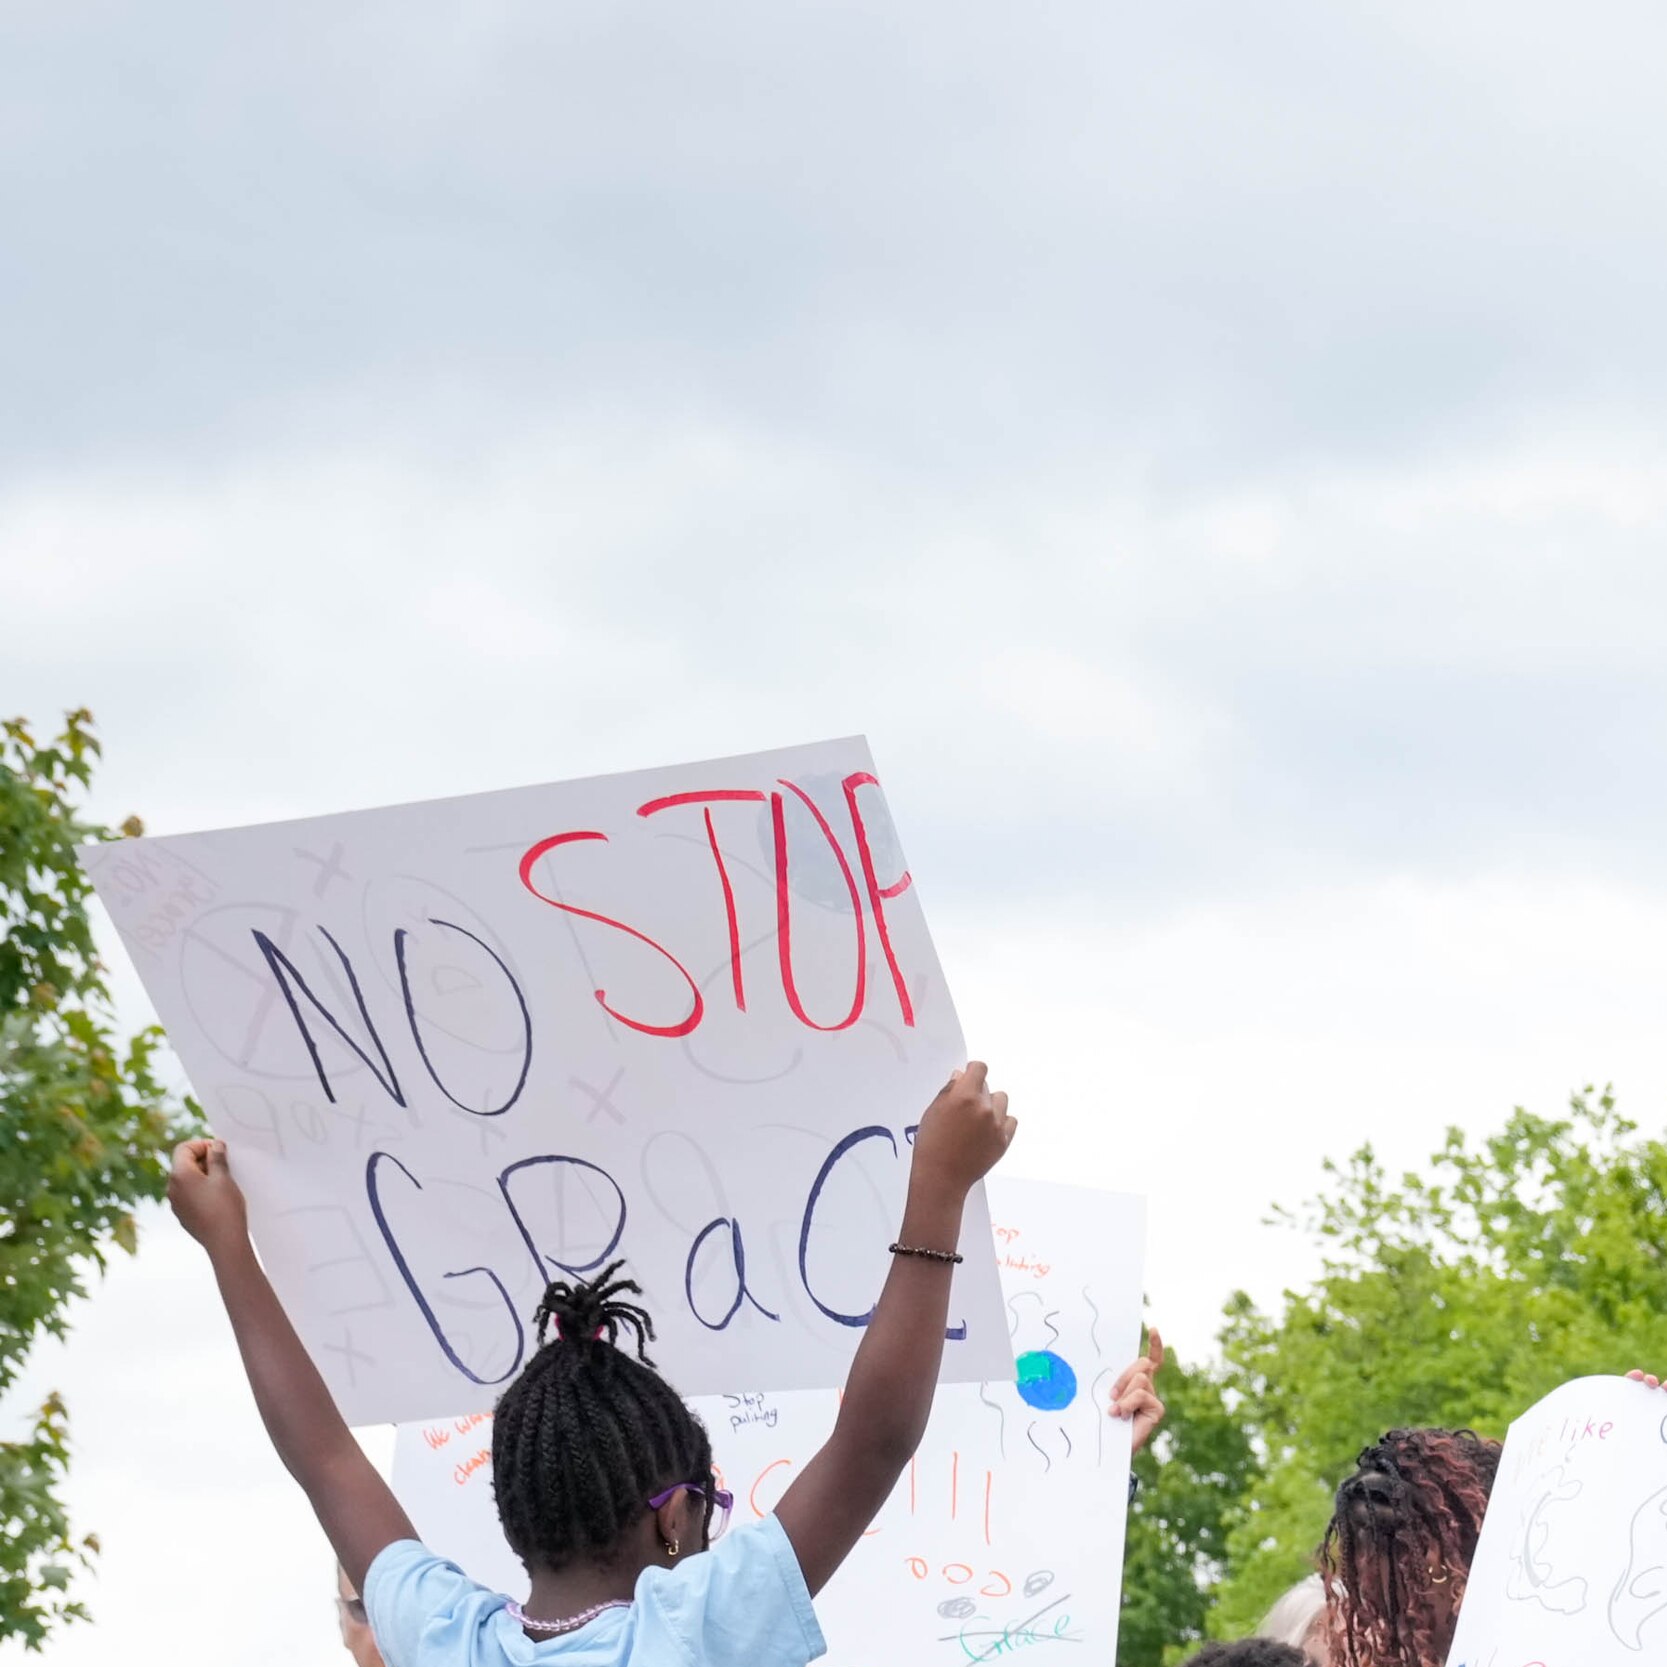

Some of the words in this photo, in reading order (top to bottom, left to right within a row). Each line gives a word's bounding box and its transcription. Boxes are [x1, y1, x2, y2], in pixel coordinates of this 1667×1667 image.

[250, 915, 534, 1116] NO
[365, 1124, 966, 1386] GRaC
[1559, 1416, 1614, 1442] like
